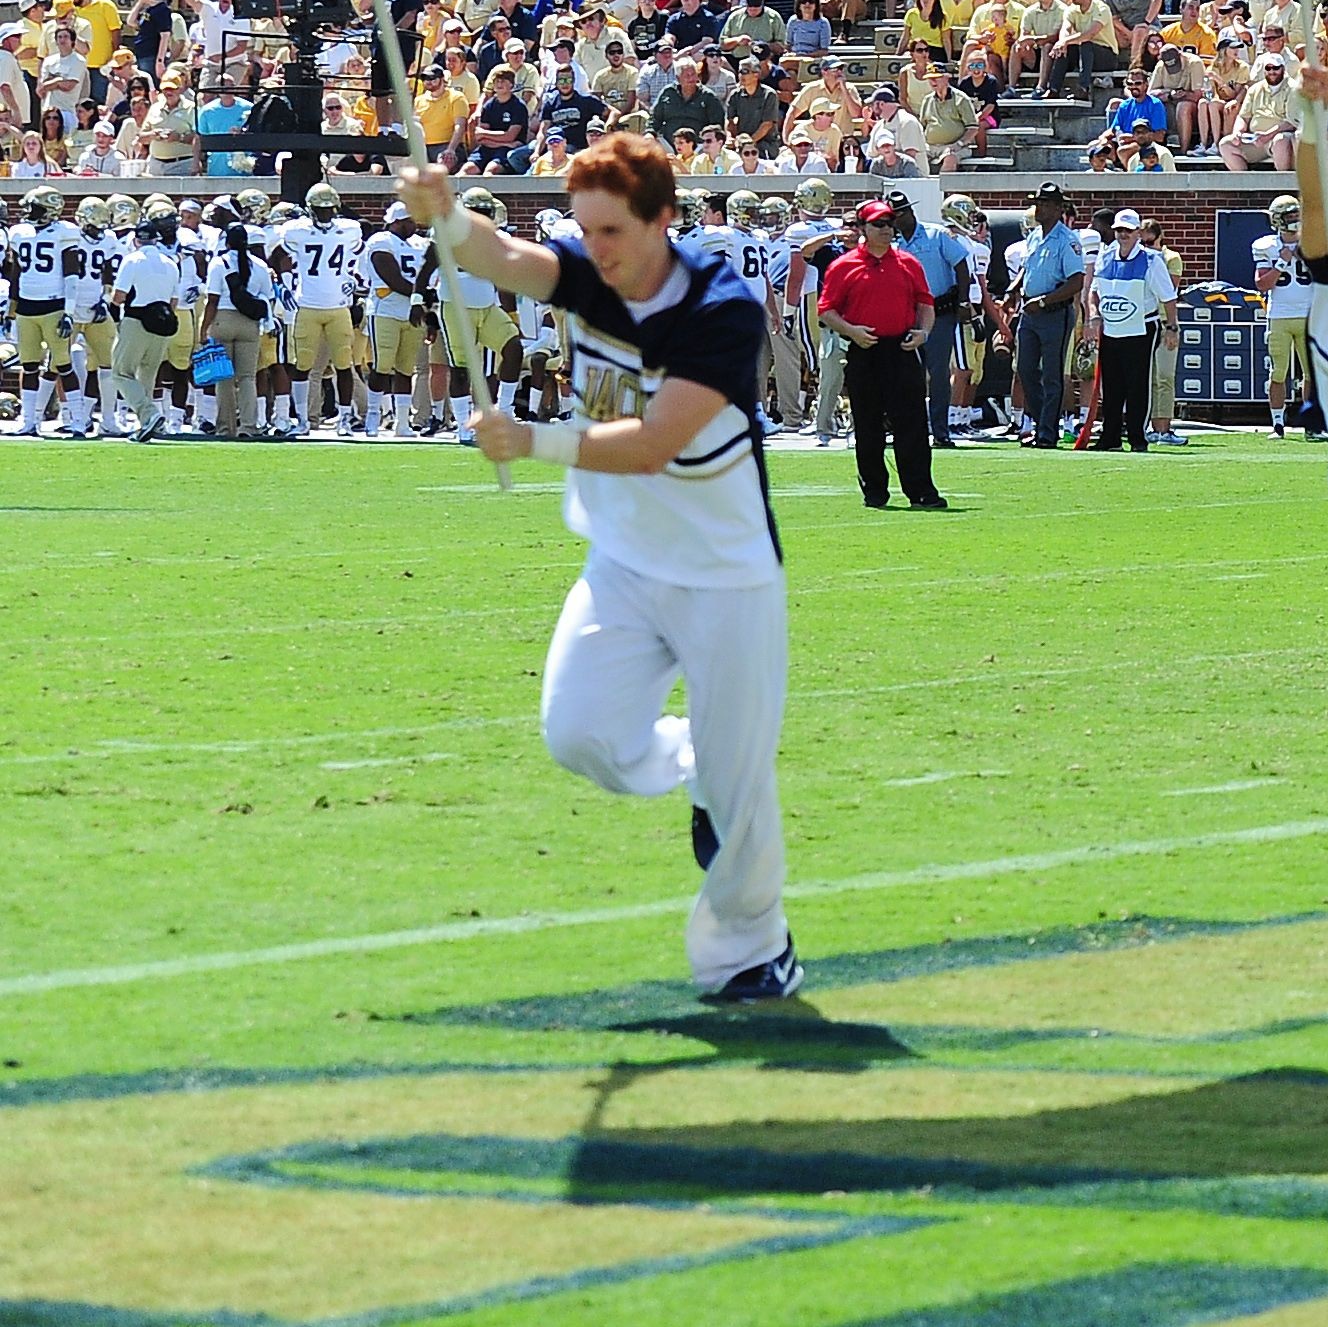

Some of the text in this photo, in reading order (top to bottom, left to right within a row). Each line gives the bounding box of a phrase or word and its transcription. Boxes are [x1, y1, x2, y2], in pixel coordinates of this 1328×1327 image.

[19, 242, 54, 273] 95
[304, 244, 344, 276] 74
[1101, 301, 1129, 311] ACC
